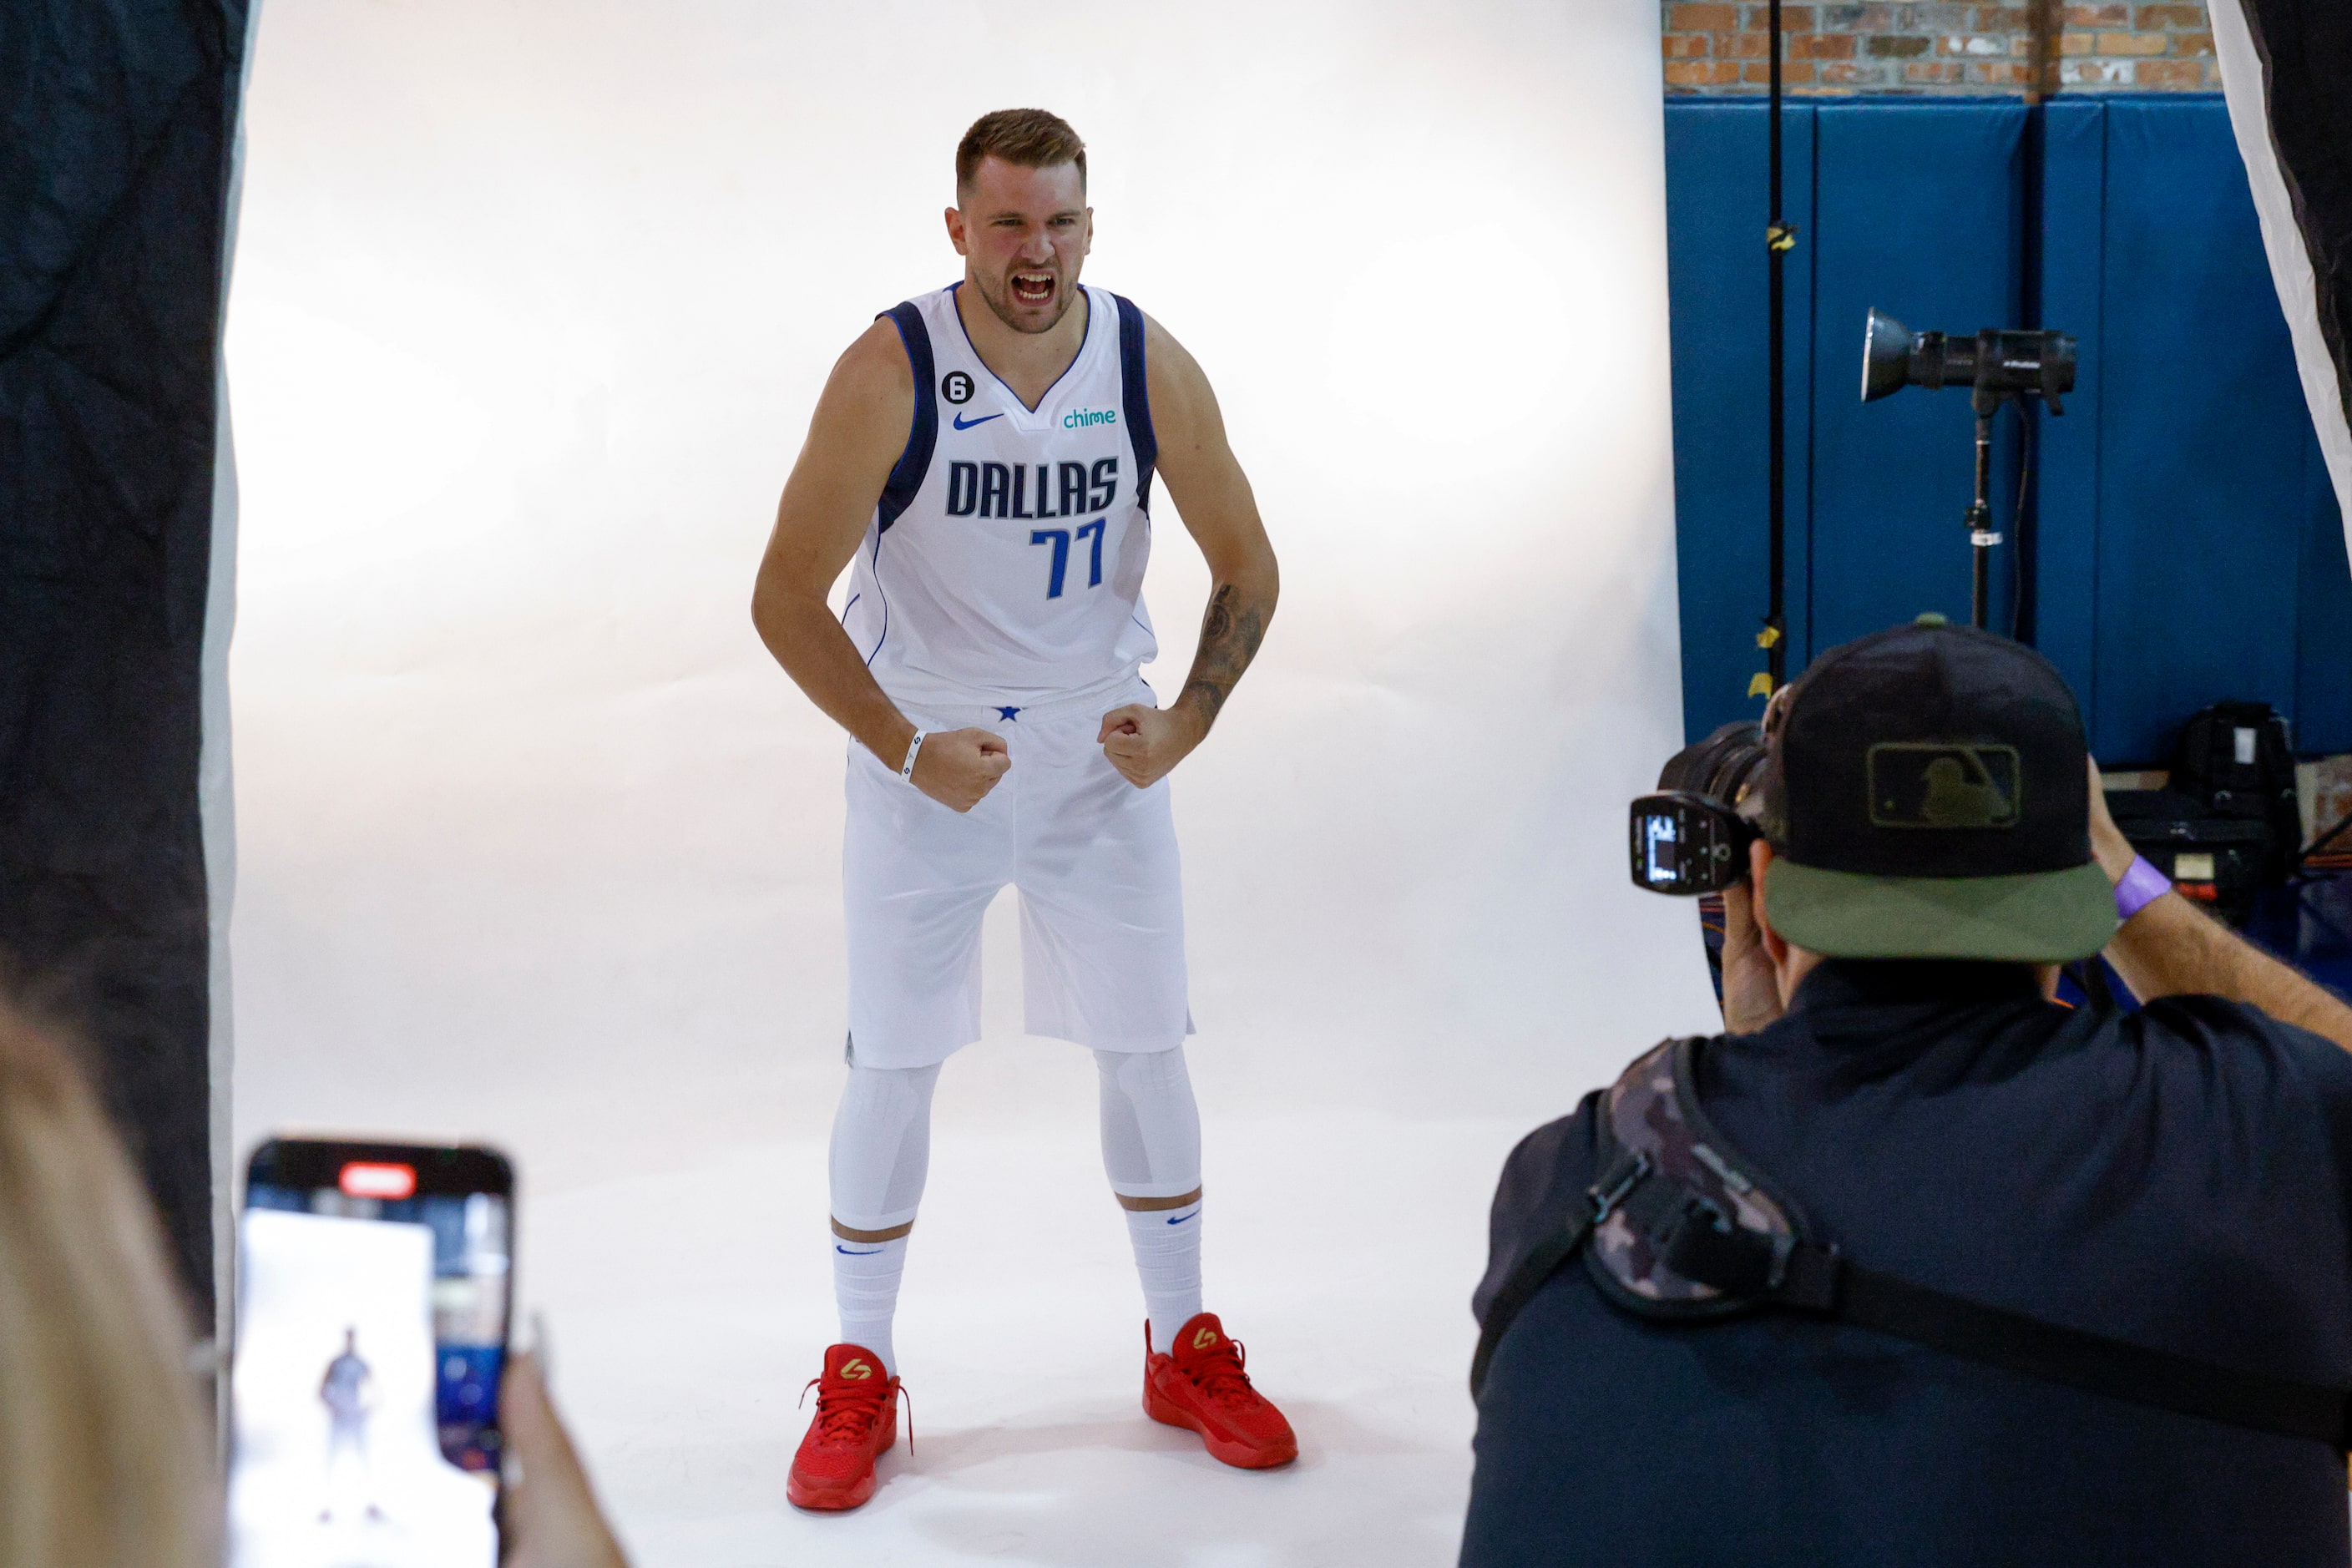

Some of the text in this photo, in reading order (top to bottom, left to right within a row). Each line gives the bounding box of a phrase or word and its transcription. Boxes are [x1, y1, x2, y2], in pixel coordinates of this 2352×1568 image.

[949, 376, 967, 401] 6
[1064, 408, 1116, 428] chime
[945, 456, 1119, 520] DALLAS
[1029, 516, 1106, 600] 77
